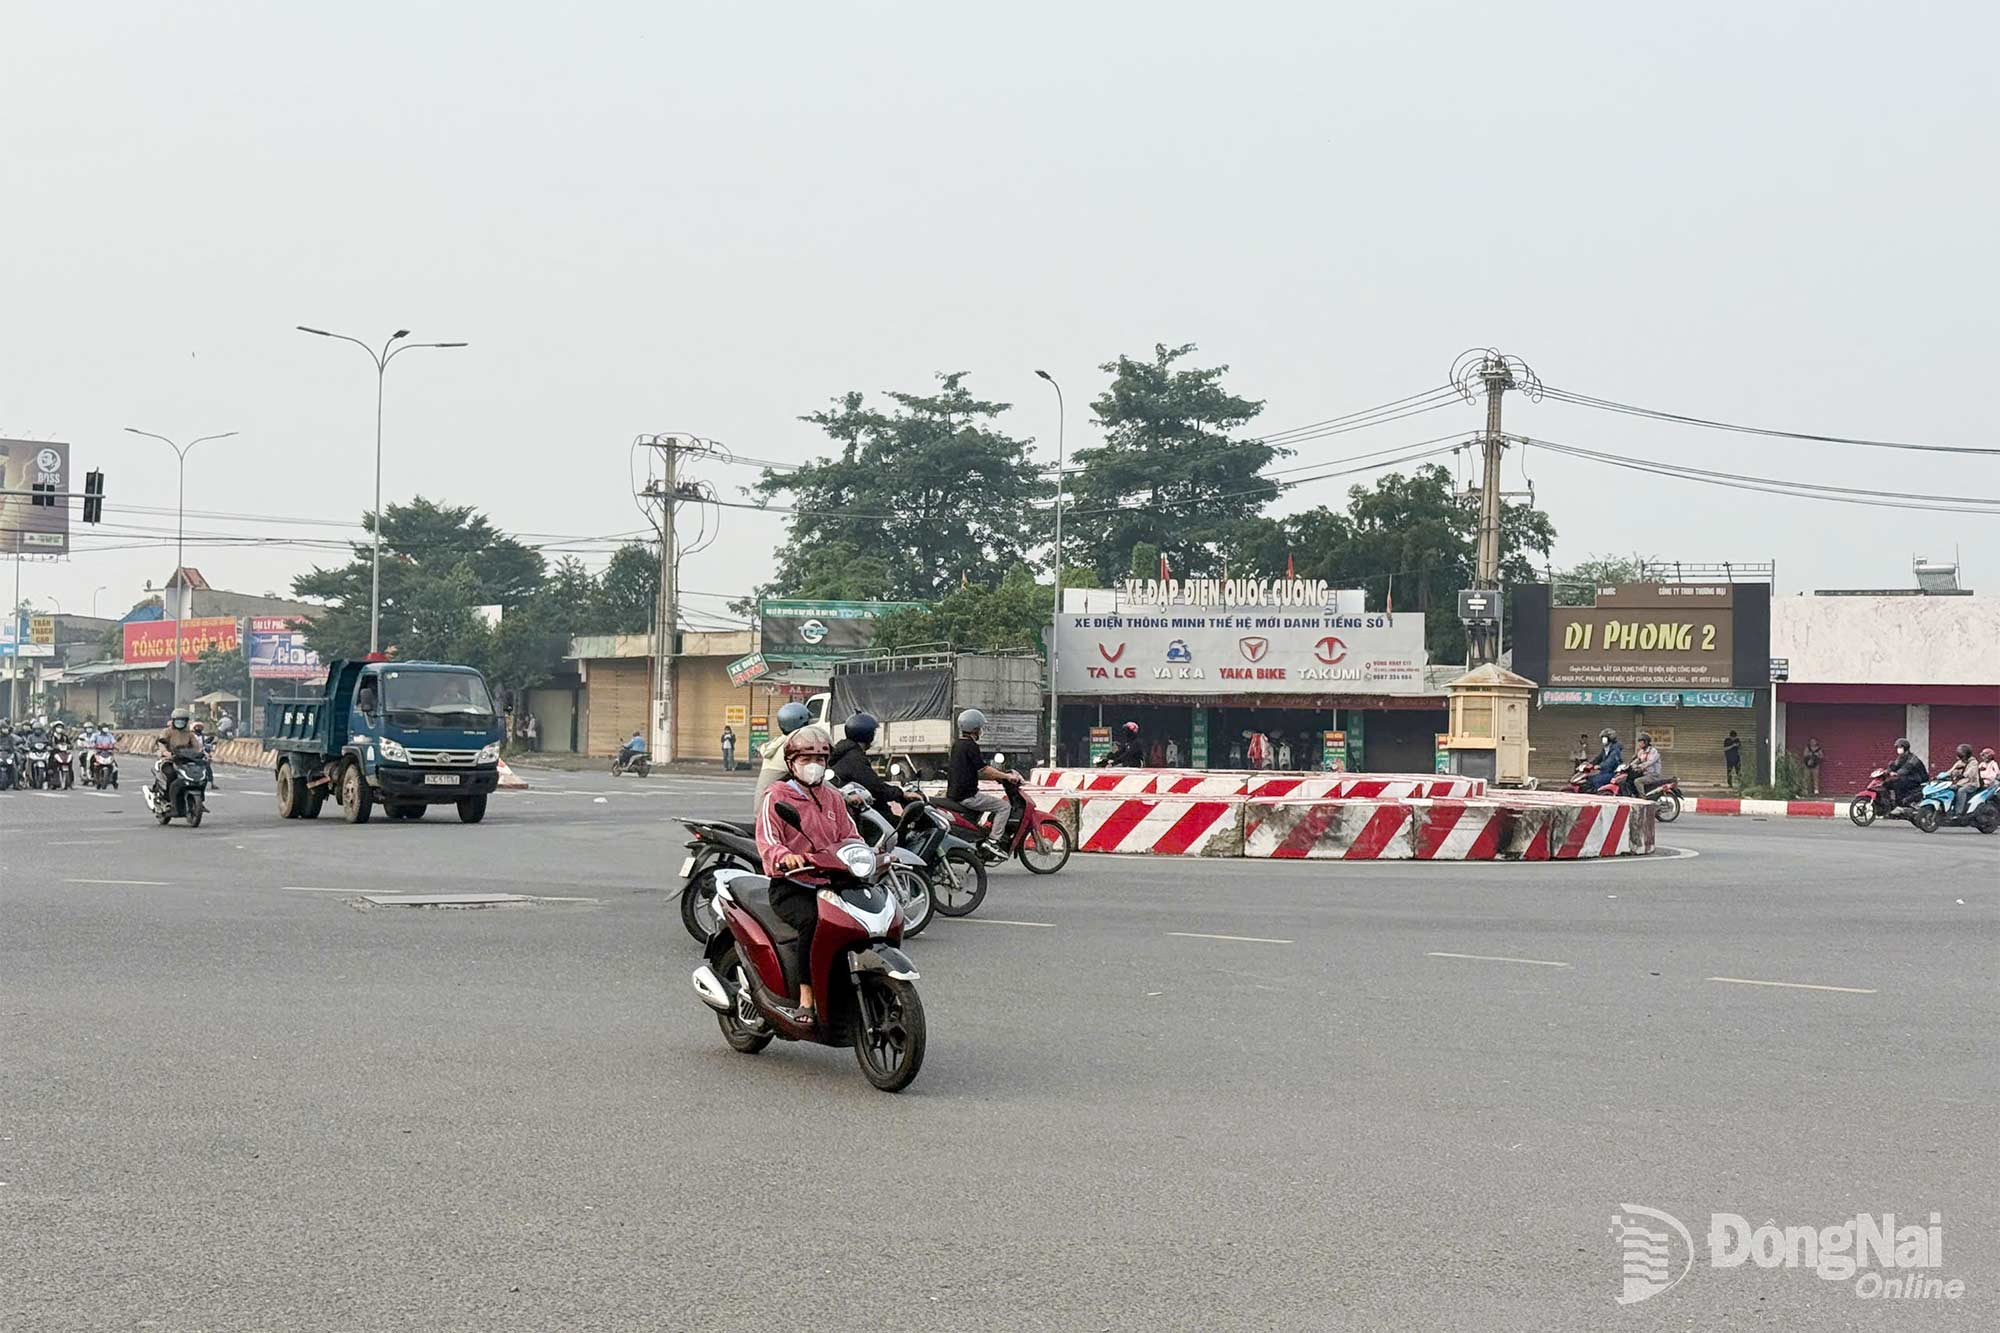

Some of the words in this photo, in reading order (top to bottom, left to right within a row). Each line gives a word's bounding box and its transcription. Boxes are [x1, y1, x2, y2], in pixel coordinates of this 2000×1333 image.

[1125, 578, 1143, 605] XE
[1147, 578, 1179, 613] ĐẠP
[1184, 573, 1219, 612] ĐIỆN
[1225, 574, 1268, 608] QUỐC
[1272, 575, 1329, 607] CƯỜNG
[1075, 618, 1090, 628] XE
[1094, 617, 1122, 630] ĐIỆN
[1127, 616, 1168, 628] THÔNG
[1172, 618, 1205, 628] MINH
[1209, 615, 1233, 628] THẾ
[1236, 616, 1252, 630] HỆ
[1255, 616, 1280, 628] MỚI
[1284, 618, 1319, 628] DANH
[1324, 615, 1362, 628] TIẾNG
[1366, 615, 1384, 628] SỐ
[1565, 622, 1593, 649] DI
[1603, 620, 1694, 649] PHONG
[1702, 624, 1716, 649] 2
[132, 631, 164, 657] TỔNG
[193, 628, 208, 655] GỖ
[731, 664, 742, 674] XE
[1219, 668, 1252, 680] YAKA
[1257, 668, 1286, 680] BIKE
[1298, 668, 1360, 680] TAKUMI
[1584, 692, 1592, 702] 2
[1599, 689, 1631, 703] SẮT
